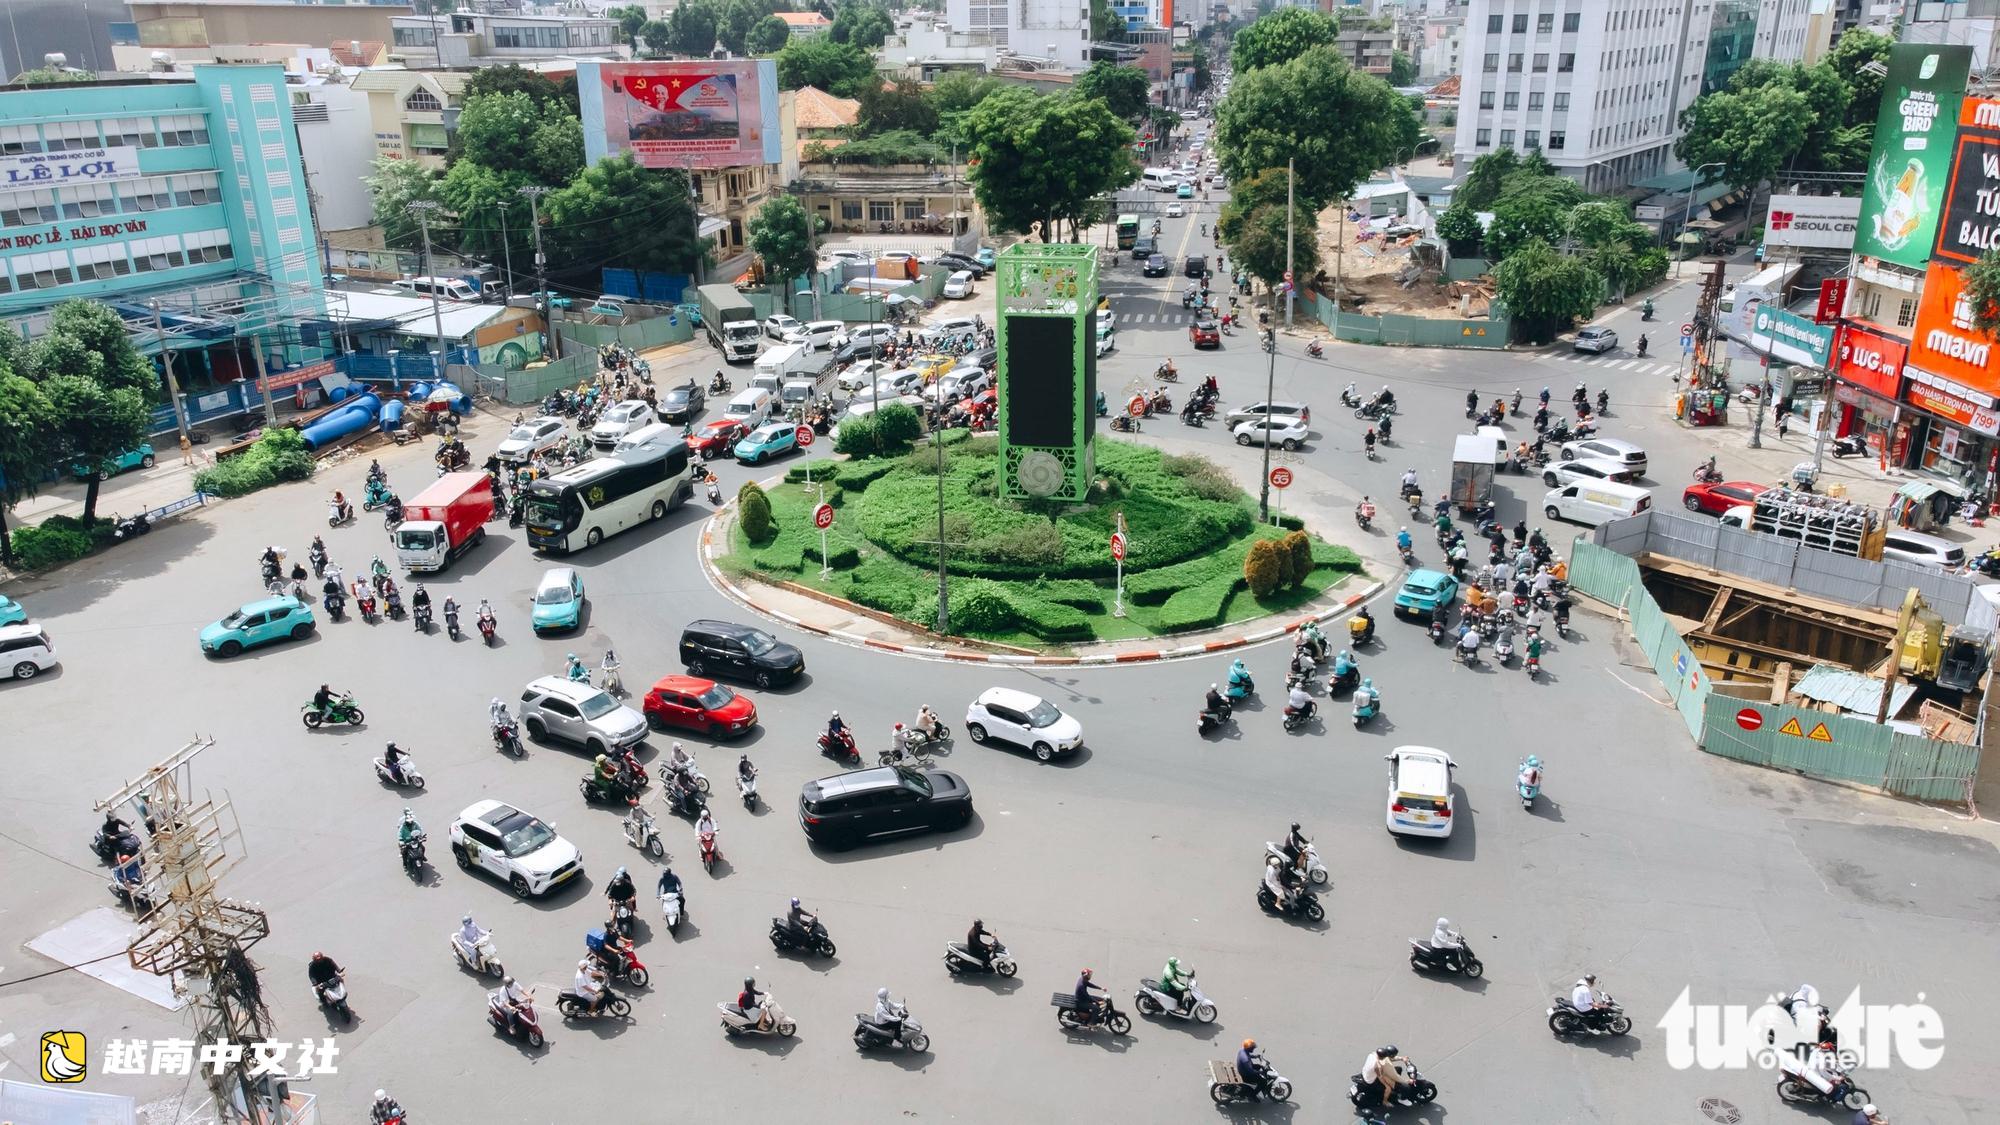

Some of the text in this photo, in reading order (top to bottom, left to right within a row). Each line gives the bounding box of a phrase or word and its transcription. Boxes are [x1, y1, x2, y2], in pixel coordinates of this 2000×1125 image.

[1899, 99, 1939, 118] GREEN
[1902, 116, 1932, 132] BIRD
[20, 155, 46, 164] TRƯỜNG
[47, 153, 68, 161] TRUNG
[68, 152, 83, 160] HỌC
[96, 149, 105, 157] SỞ
[6, 160, 117, 182] LÊ LỢI
[14, 233, 43, 249] HỌC
[70, 226, 97, 241] HẬU
[98, 223, 123, 238] HỌC
[123, 218, 147, 233] VĂN
[1794, 222, 1832, 231] SEOUL
[1852, 347, 1895, 377] LUG.vn
[1911, 382, 1925, 396] BẢO
[1924, 388, 1944, 403] HÀNH
[1944, 396, 1961, 411] TRỌN
[1961, 402, 1975, 415] ĐỜI
[797, 432, 811, 443] 5G
[1273, 474, 1289, 485] 5G
[818, 511, 831, 526] 5G
[1112, 543, 1122, 556] 5G
